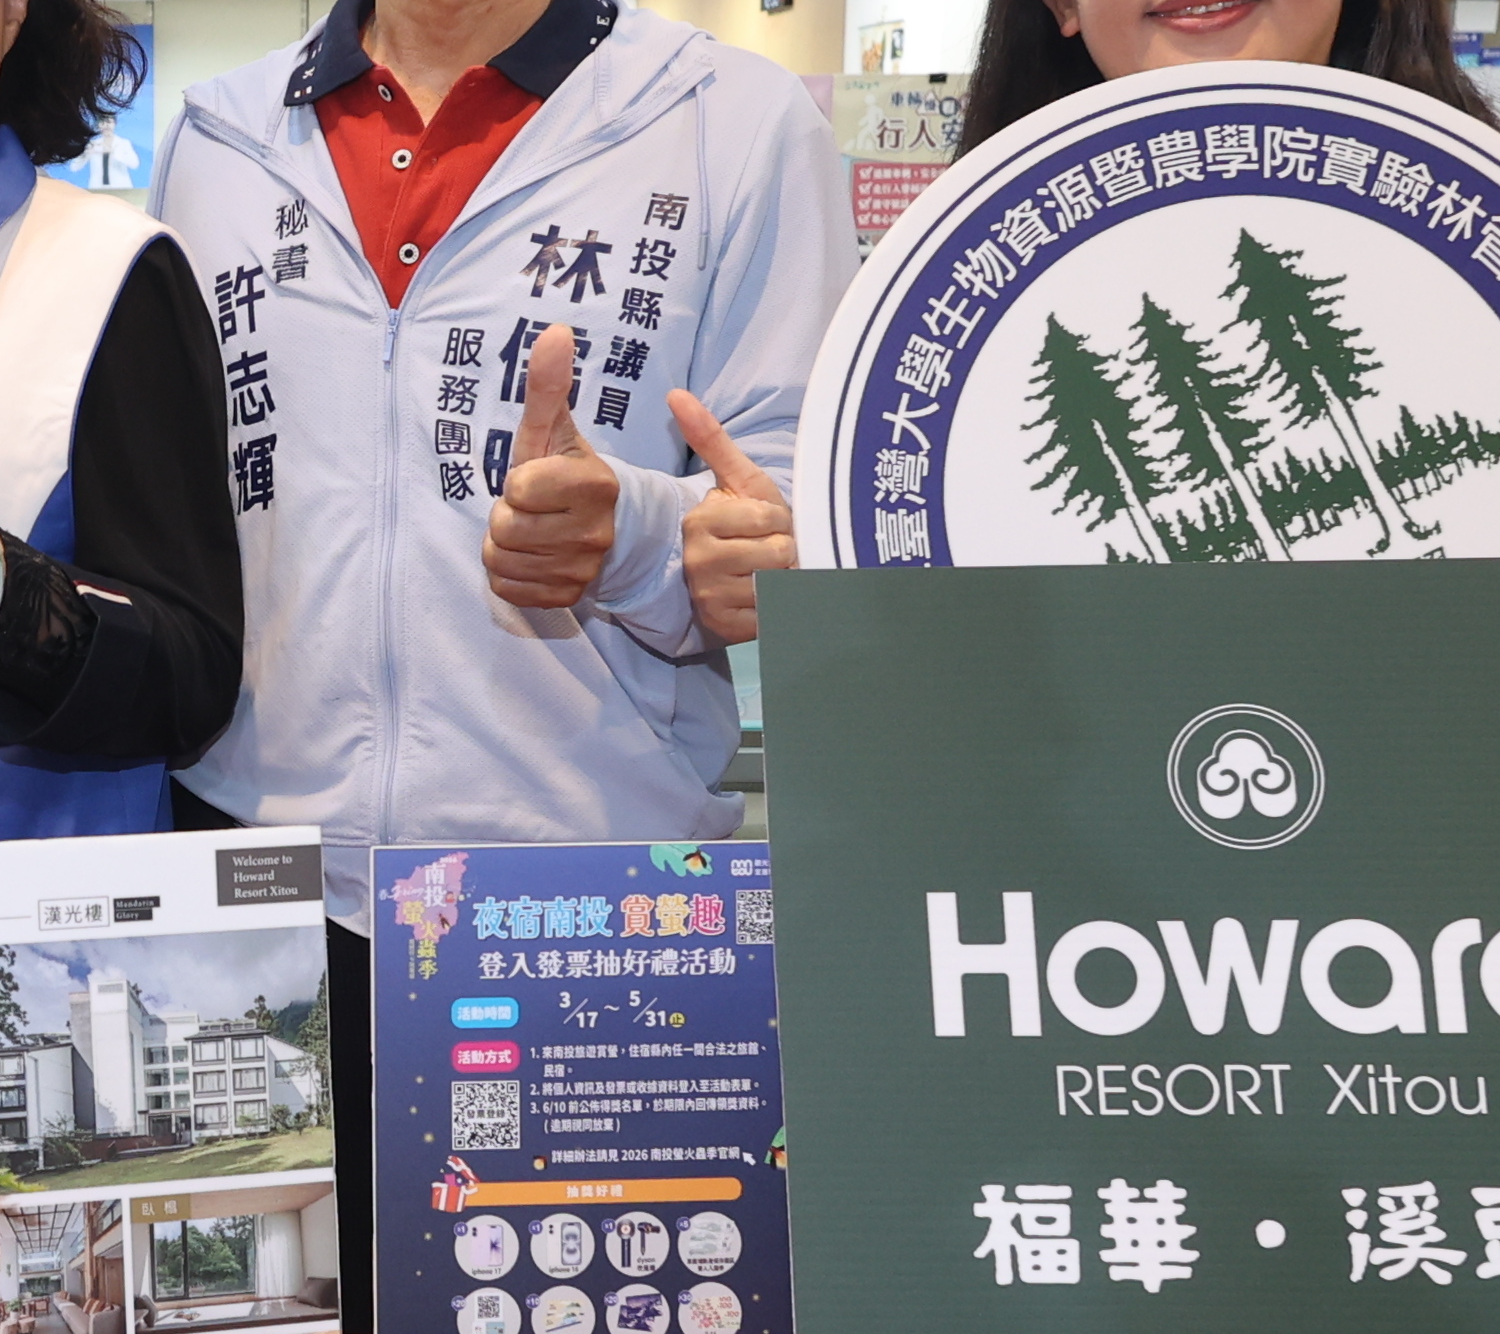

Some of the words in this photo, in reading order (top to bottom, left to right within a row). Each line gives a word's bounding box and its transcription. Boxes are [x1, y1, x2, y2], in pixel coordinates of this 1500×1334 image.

[877, 118, 963, 149] 行人安
[271, 198, 309, 284] 秘書
[593, 192, 690, 431] 南投縣議員
[482, 223, 613, 499] 林儒
[213, 264, 278, 516] 許志輝
[434, 326, 485, 502] 服務團隊
[233, 855, 278, 868] Welcome
[281, 854, 293, 866] to
[233, 870, 276, 884] Howard
[423, 862, 447, 908] 南投
[116, 898, 156, 909] Mandarin
[234, 885, 268, 899] Resort
[269, 884, 299, 897] Xitou
[44, 903, 104, 927] 漢光樓
[116, 910, 141, 922] Glory
[472, 894, 614, 940] 夜宿南投
[619, 893, 726, 938] 賞螢趣
[402, 900, 439, 981] 螢火蟲季
[478, 946, 736, 980] 登入發票抽好禮活動
[457, 1050, 512, 1065] 活動方式
[529, 1047, 541, 1060] 1.
[529, 1083, 541, 1096] 2.
[1055, 1063, 1291, 1117] RESORT
[1325, 1063, 1489, 1118] Xitou
[529, 1101, 541, 1115] 3.
[542, 1101, 566, 1115] 6/10
[621, 1148, 649, 1162] 2026
